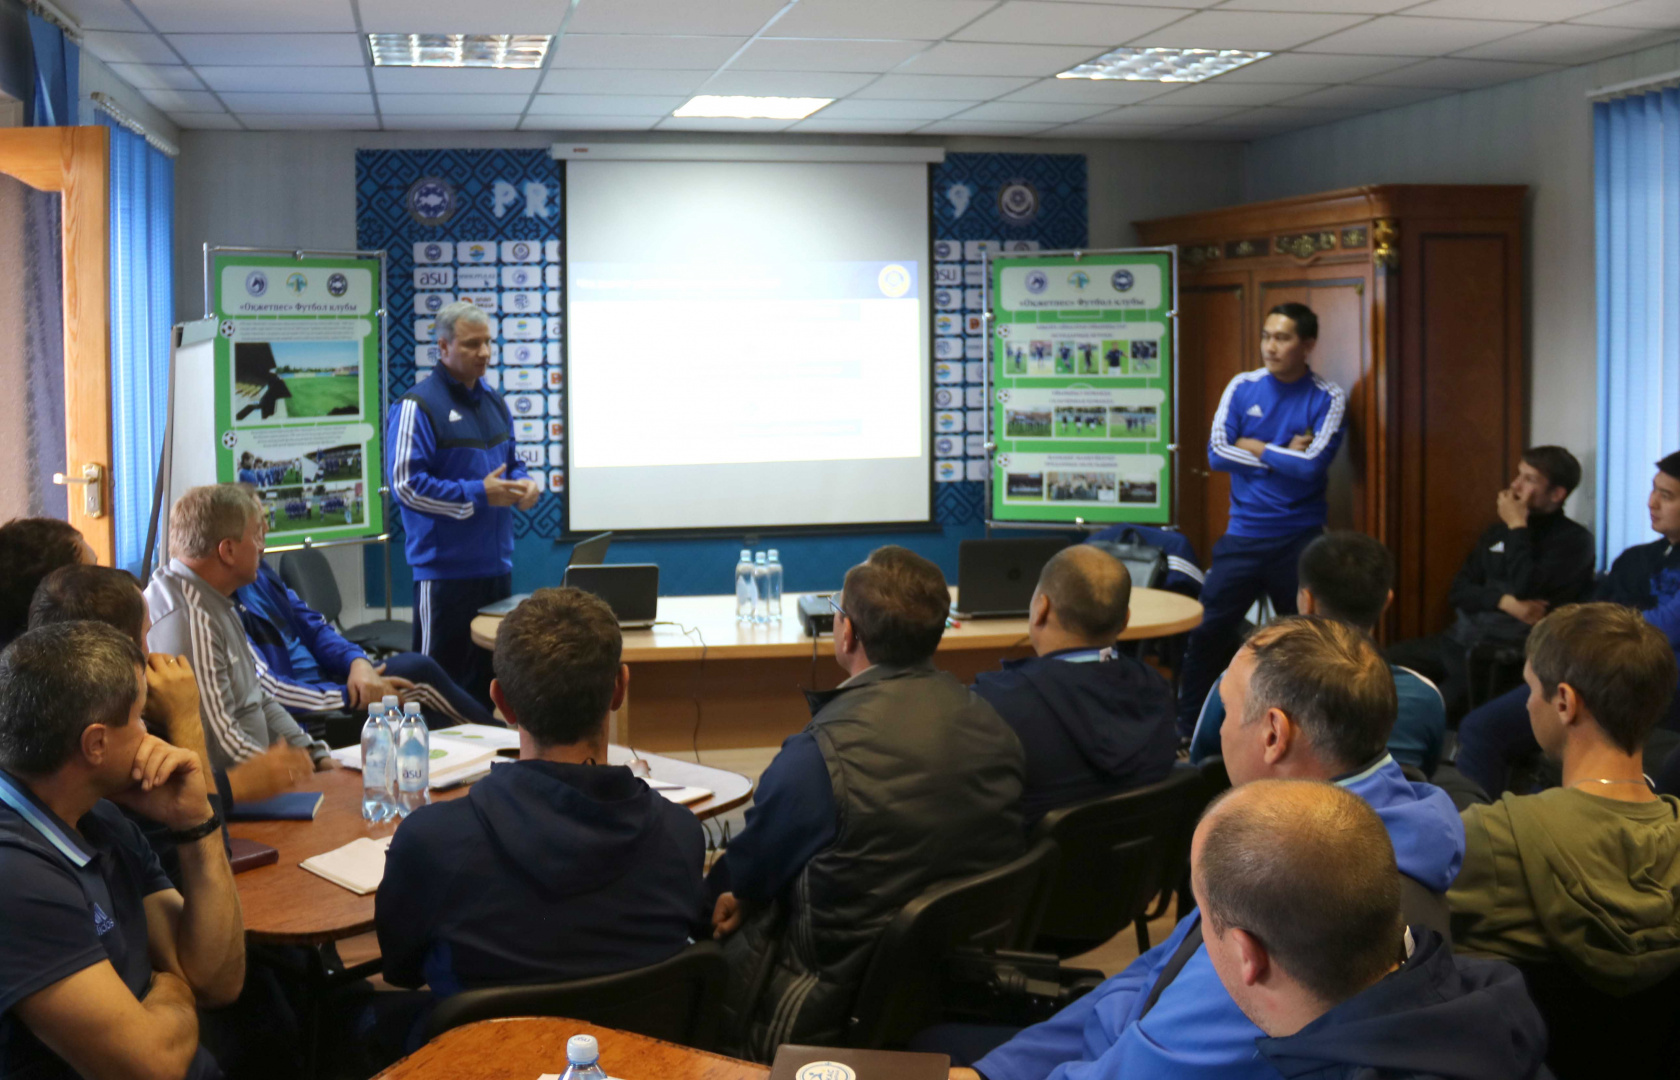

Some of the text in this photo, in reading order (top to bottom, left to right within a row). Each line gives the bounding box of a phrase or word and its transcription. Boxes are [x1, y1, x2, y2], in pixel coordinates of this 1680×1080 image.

[419, 272, 448, 285] asu
[295, 302, 328, 313] Футбол
[329, 302, 357, 312] клубы
[402, 767, 422, 779] asu
